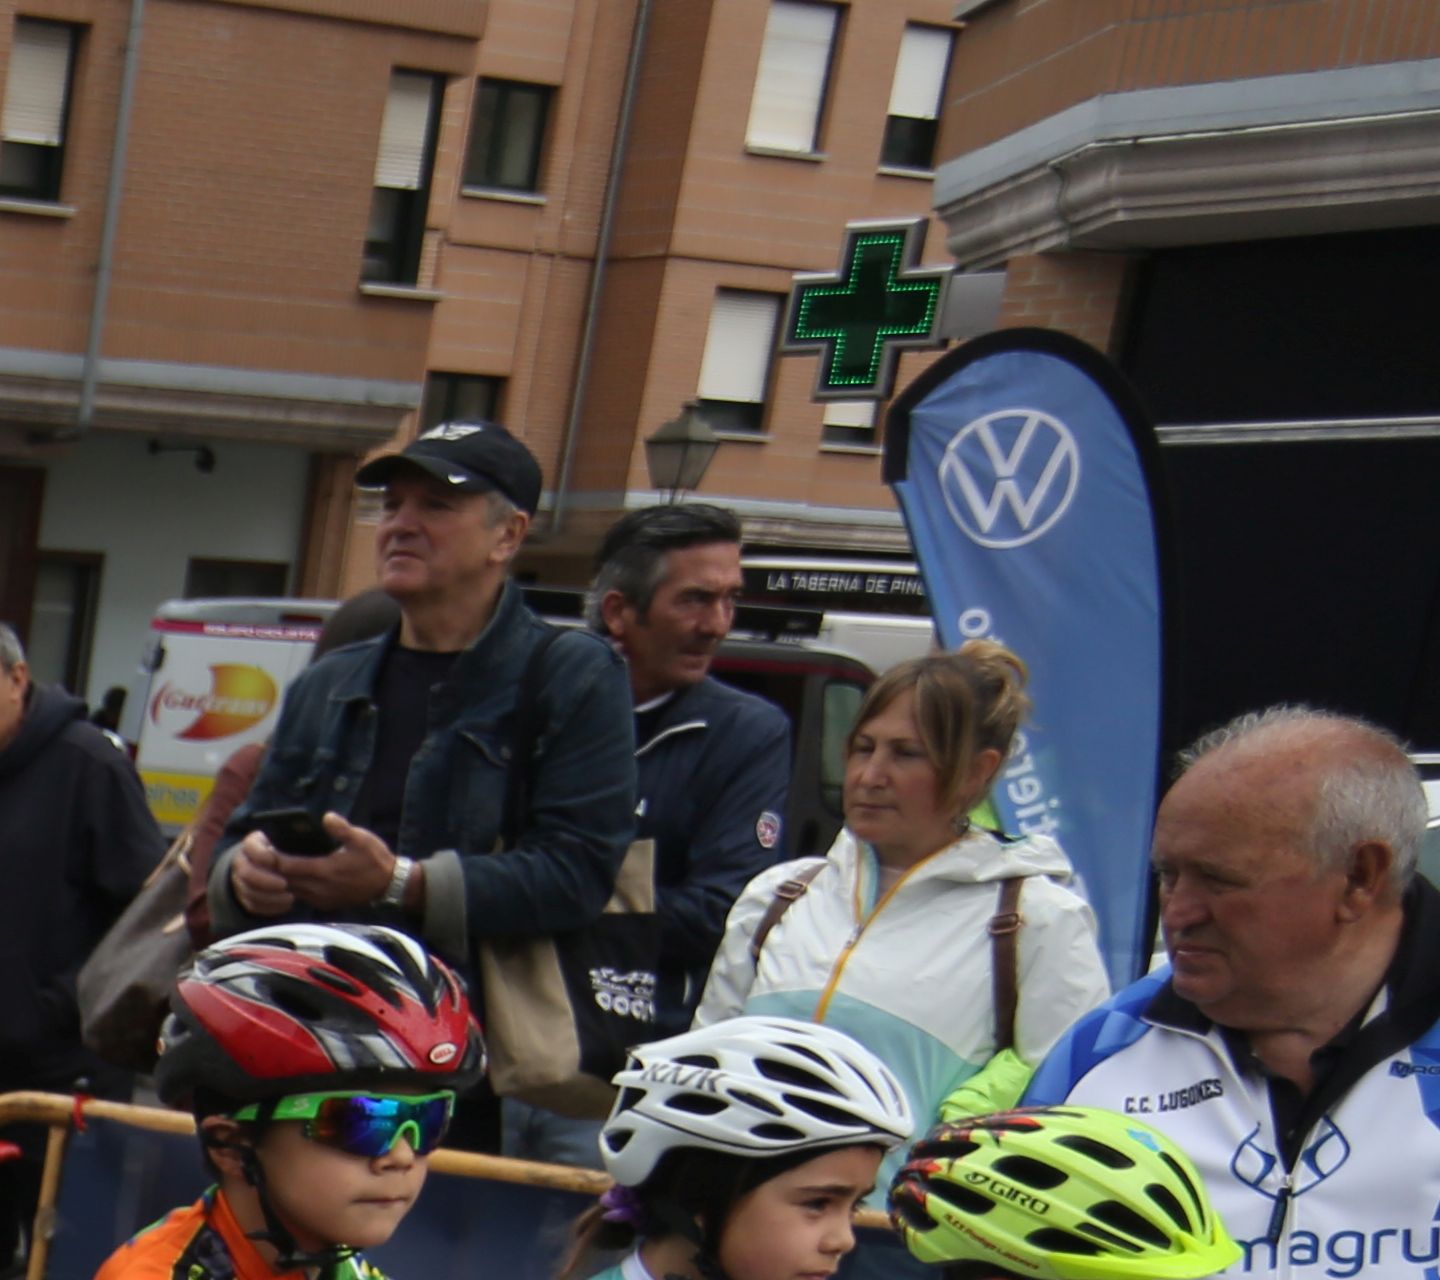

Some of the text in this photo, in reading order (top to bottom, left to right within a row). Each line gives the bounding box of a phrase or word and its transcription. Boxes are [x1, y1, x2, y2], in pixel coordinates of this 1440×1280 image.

[791, 575, 860, 592] TABERNA
[865, 579, 888, 593] DE
[988, 1179, 1051, 1215] GIRO
